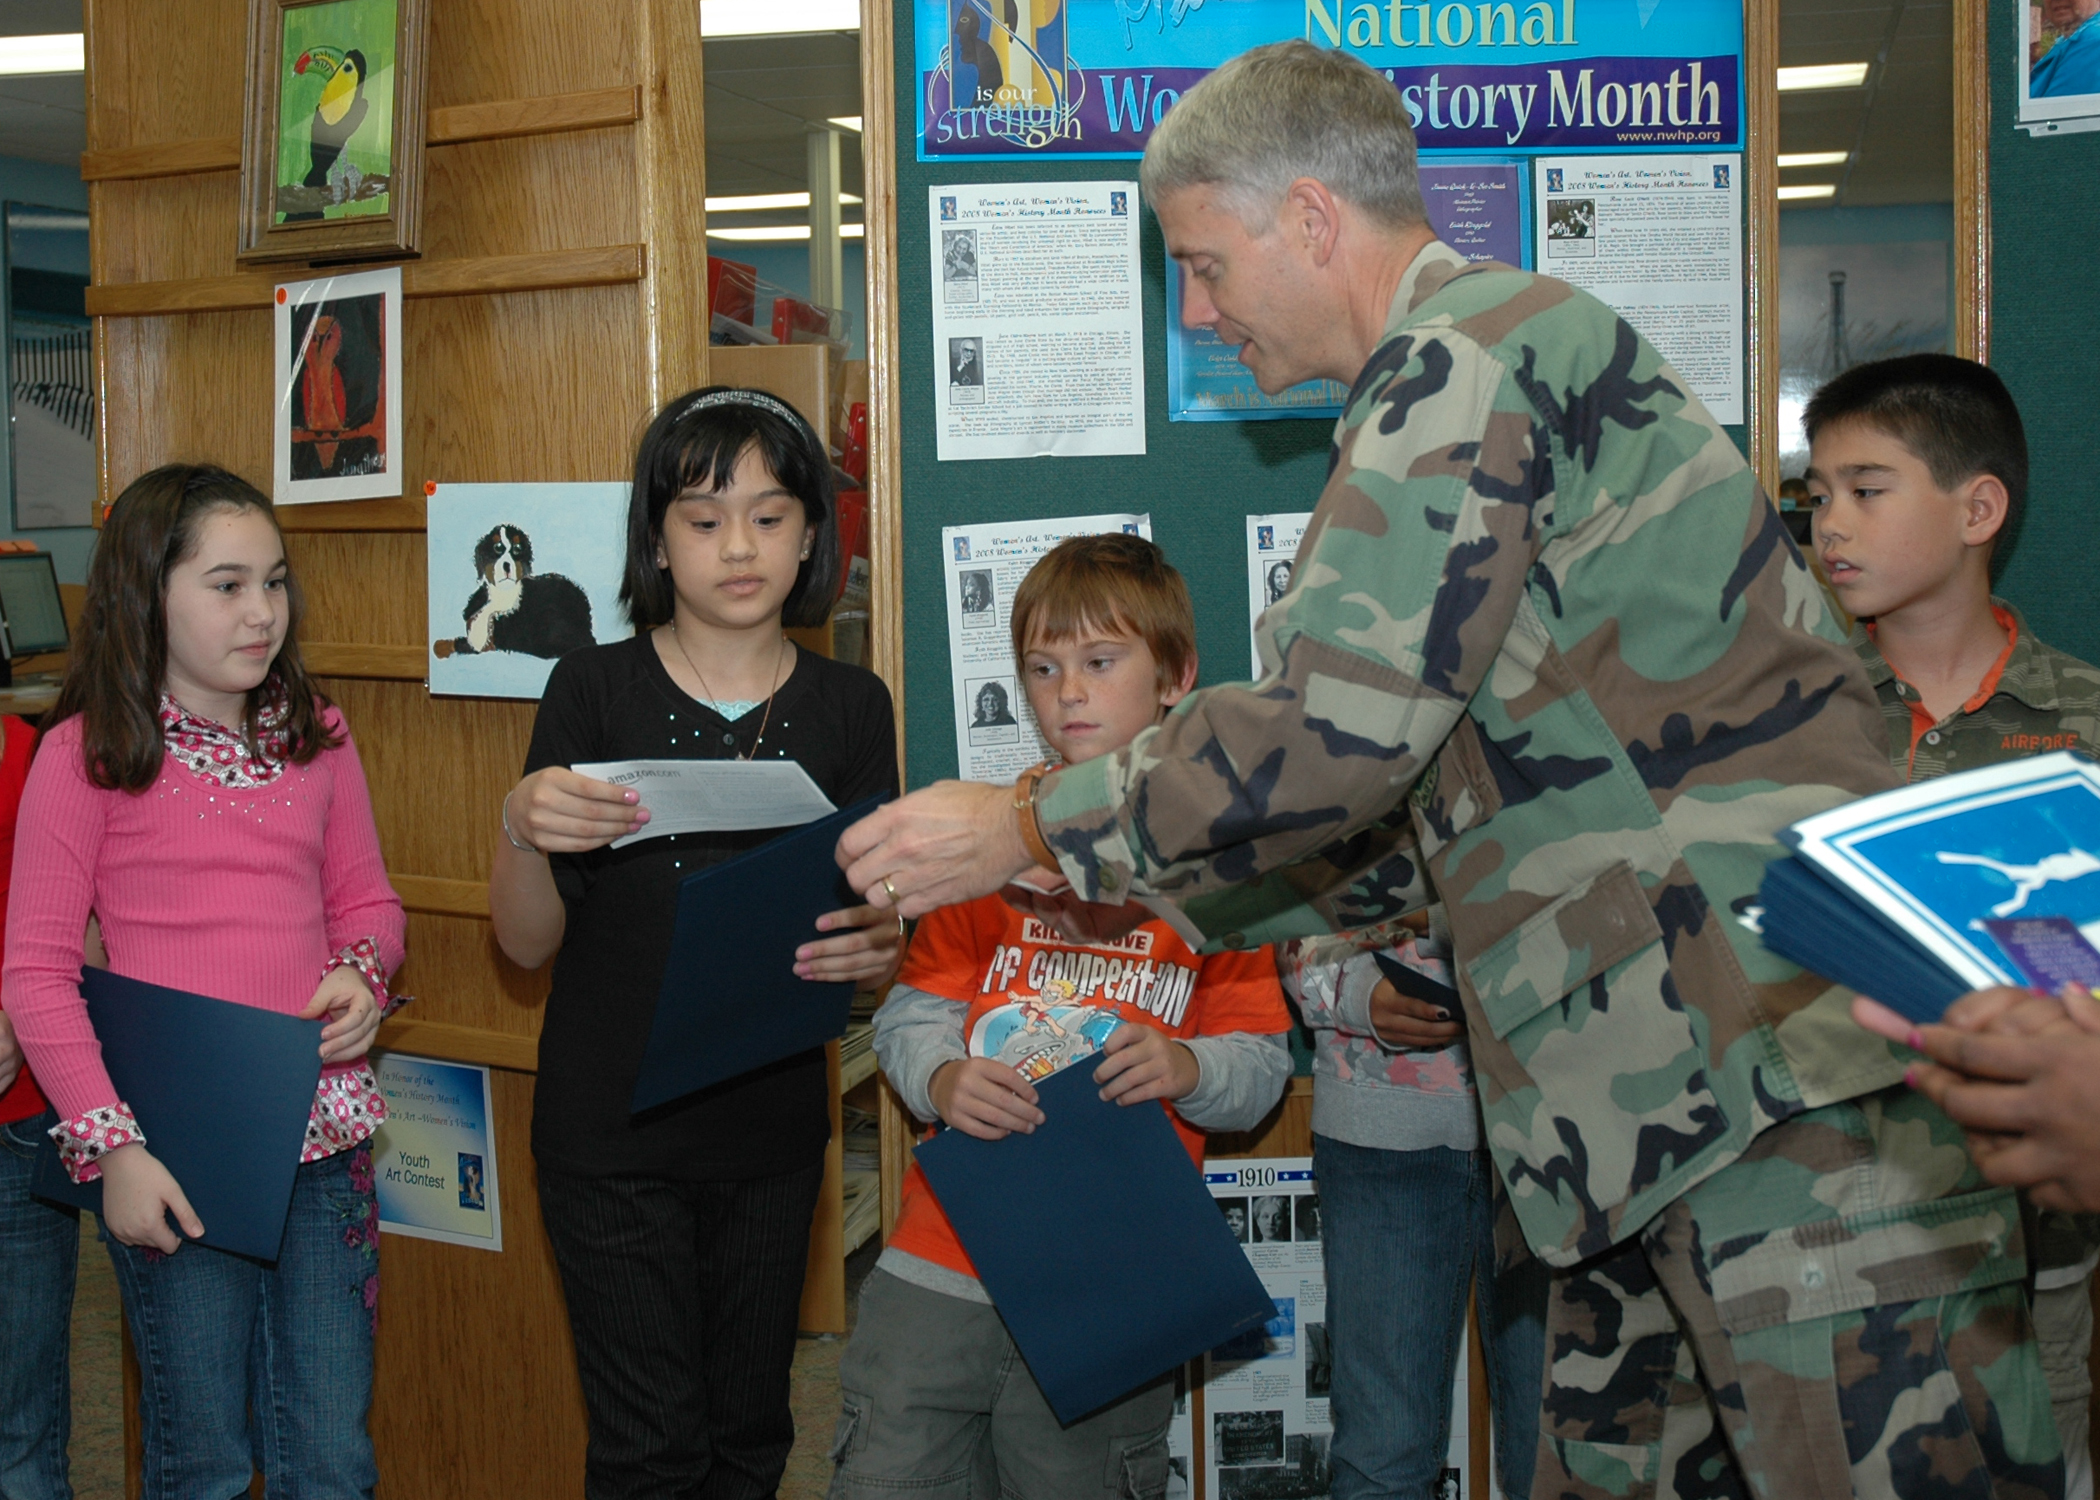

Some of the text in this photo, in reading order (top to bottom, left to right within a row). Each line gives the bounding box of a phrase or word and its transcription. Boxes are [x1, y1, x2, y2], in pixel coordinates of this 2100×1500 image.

[1304, 0, 1579, 48] National
[976, 85, 1037, 102] is our
[1386, 62, 1721, 145] story Month
[937, 97, 1083, 149] strength
[1617, 130, 1721, 143] www.nwhp.org
[1622, 182, 1649, 190] History
[1651, 181, 1674, 189] Month
[1018, 209, 1045, 217] History
[1196, 385, 1245, 408] March
[1248, 387, 1260, 407] is
[1264, 378, 1327, 407] National
[1030, 546, 1055, 554] Histo
[607, 769, 682, 785] amazon.com
[382, 1071, 435, 1087] In Honor of the
[408, 1090, 435, 1106] History
[436, 1094, 460, 1105] Month
[403, 1111, 416, 1121] Art
[455, 1118, 477, 1130] Vision
[399, 1151, 430, 1169] Youth
[385, 1167, 446, 1190] Art Contest
[1237, 1167, 1276, 1188] 1910
